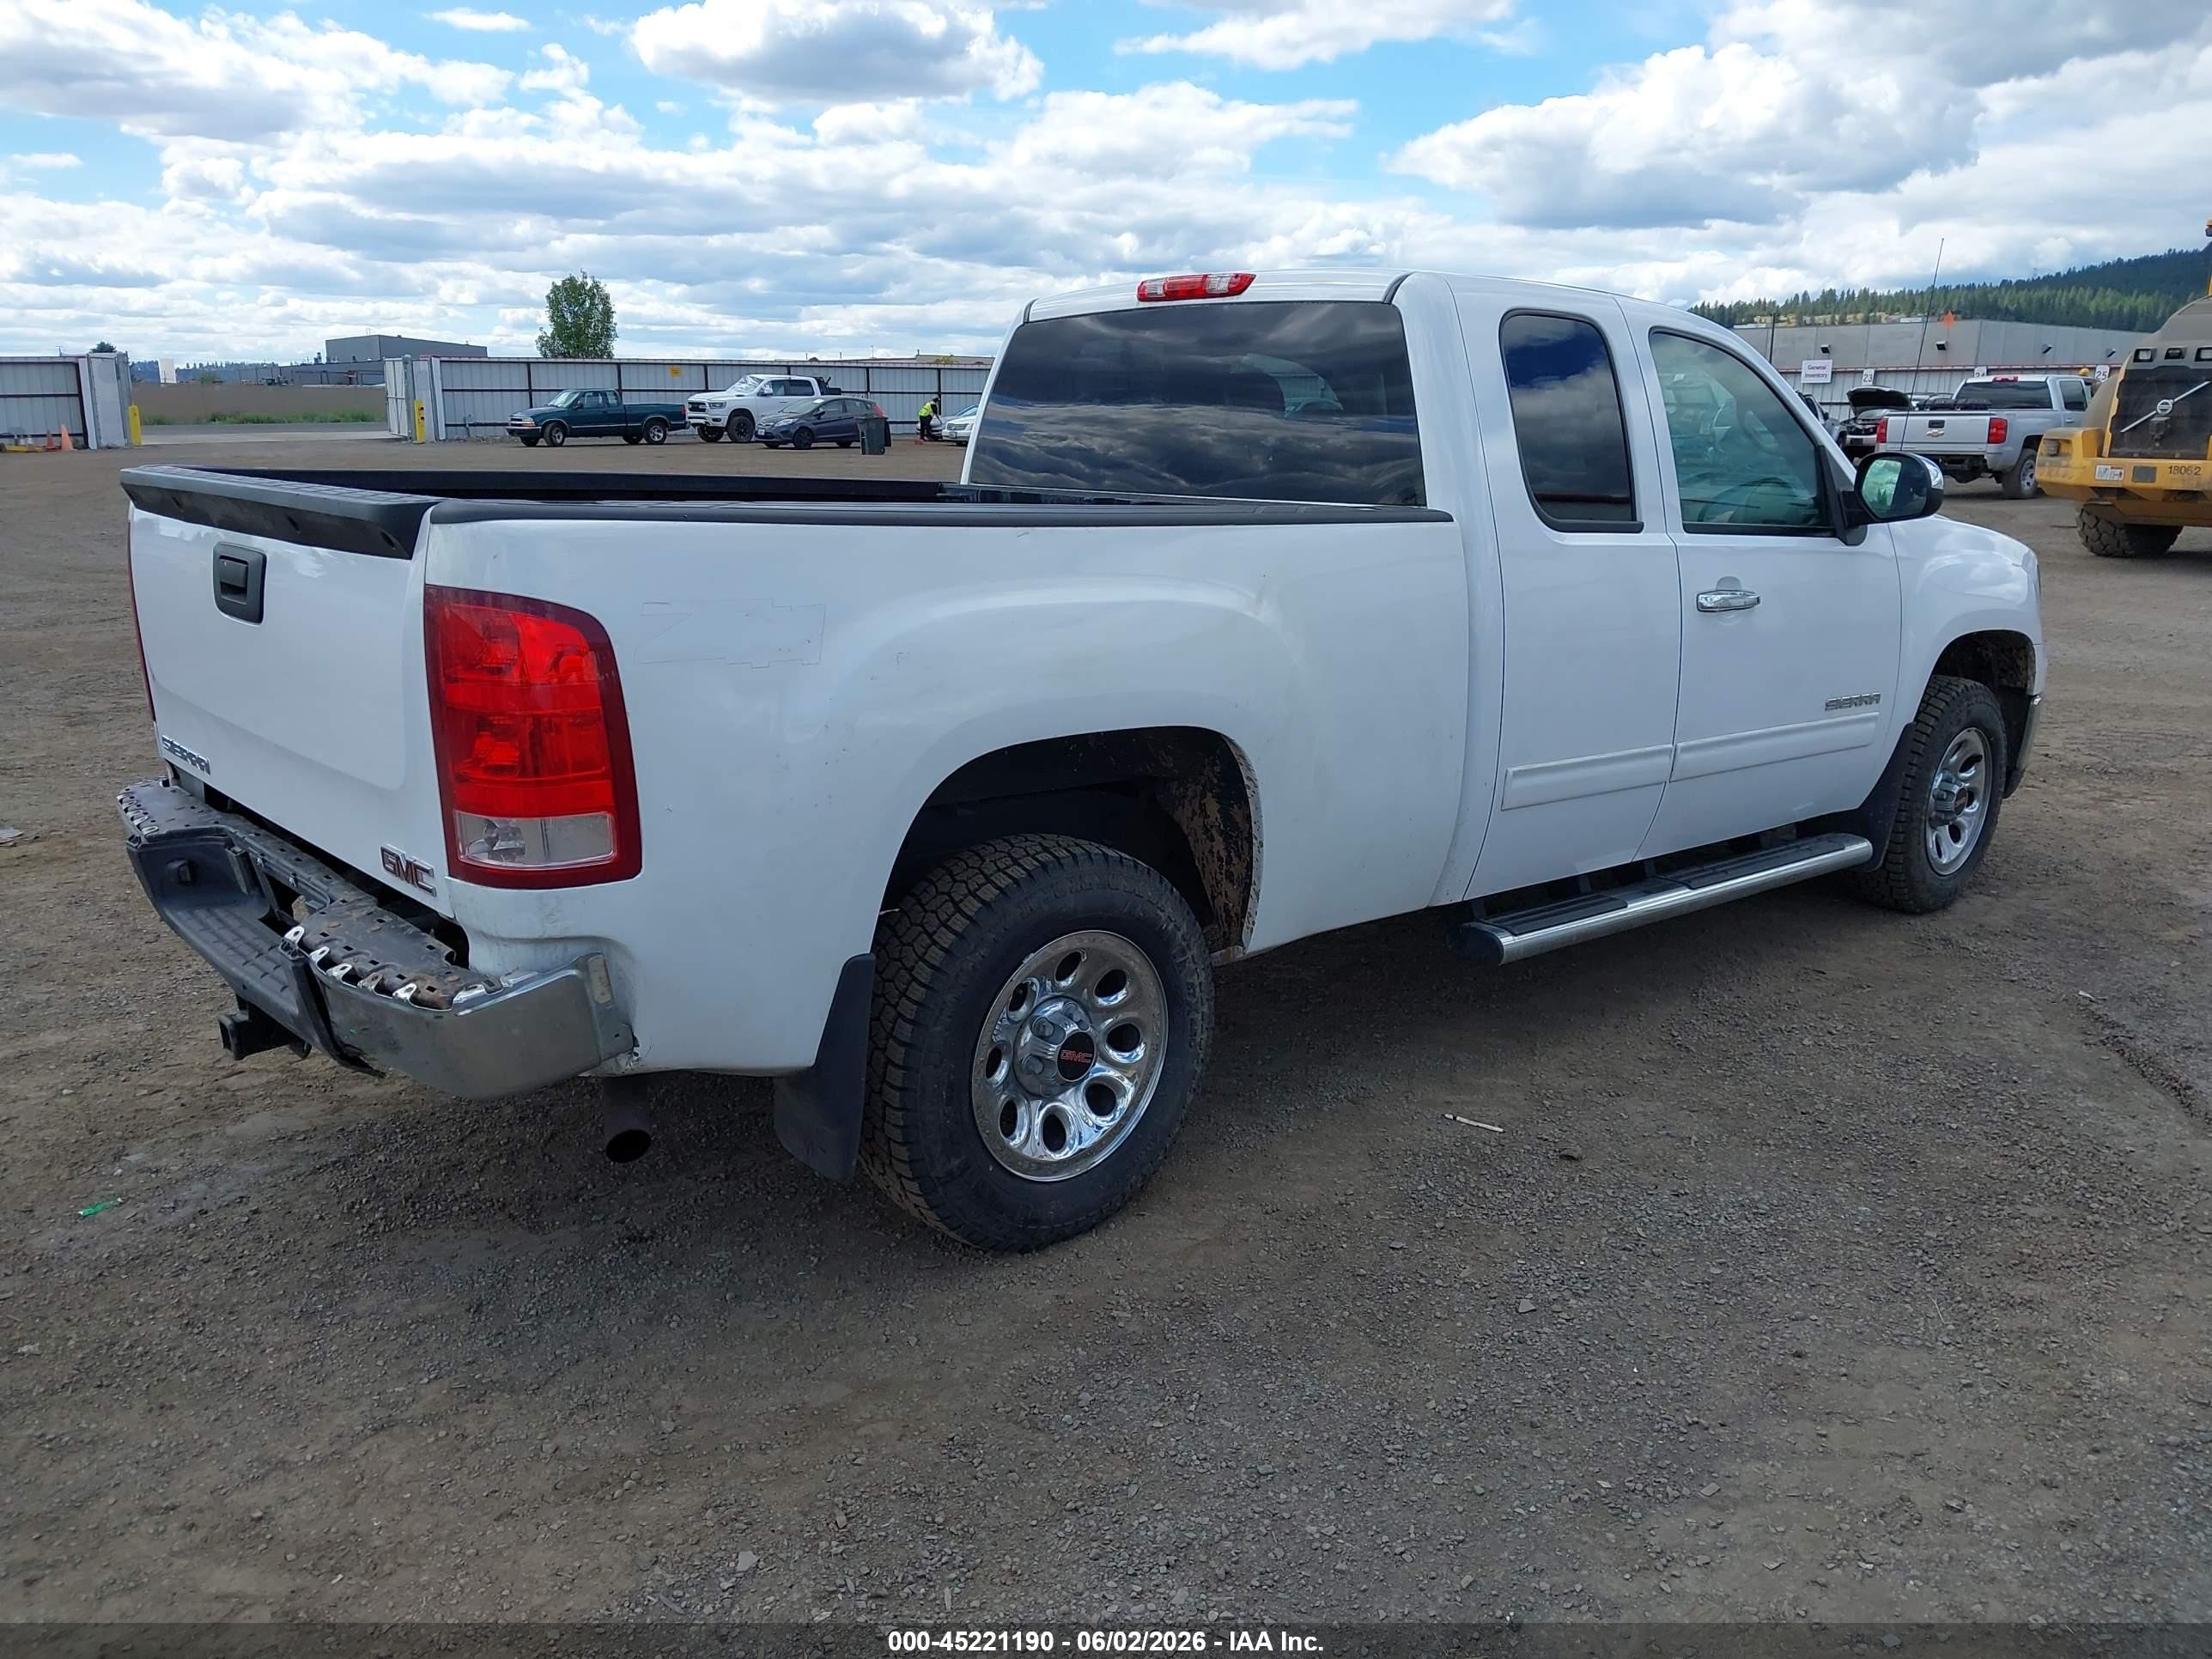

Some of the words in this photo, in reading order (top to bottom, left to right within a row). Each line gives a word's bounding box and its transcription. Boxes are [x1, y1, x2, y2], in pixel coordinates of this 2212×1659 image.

[1863, 374, 1873, 382] 23
[2095, 371, 2107, 380] 25
[2168, 465, 2202, 476] 18062
[1825, 692, 1881, 711] SIERRA
[161, 734, 211, 775] SIERRA
[380, 843, 437, 897] GMC
[1060, 1049, 1093, 1063] GMC
